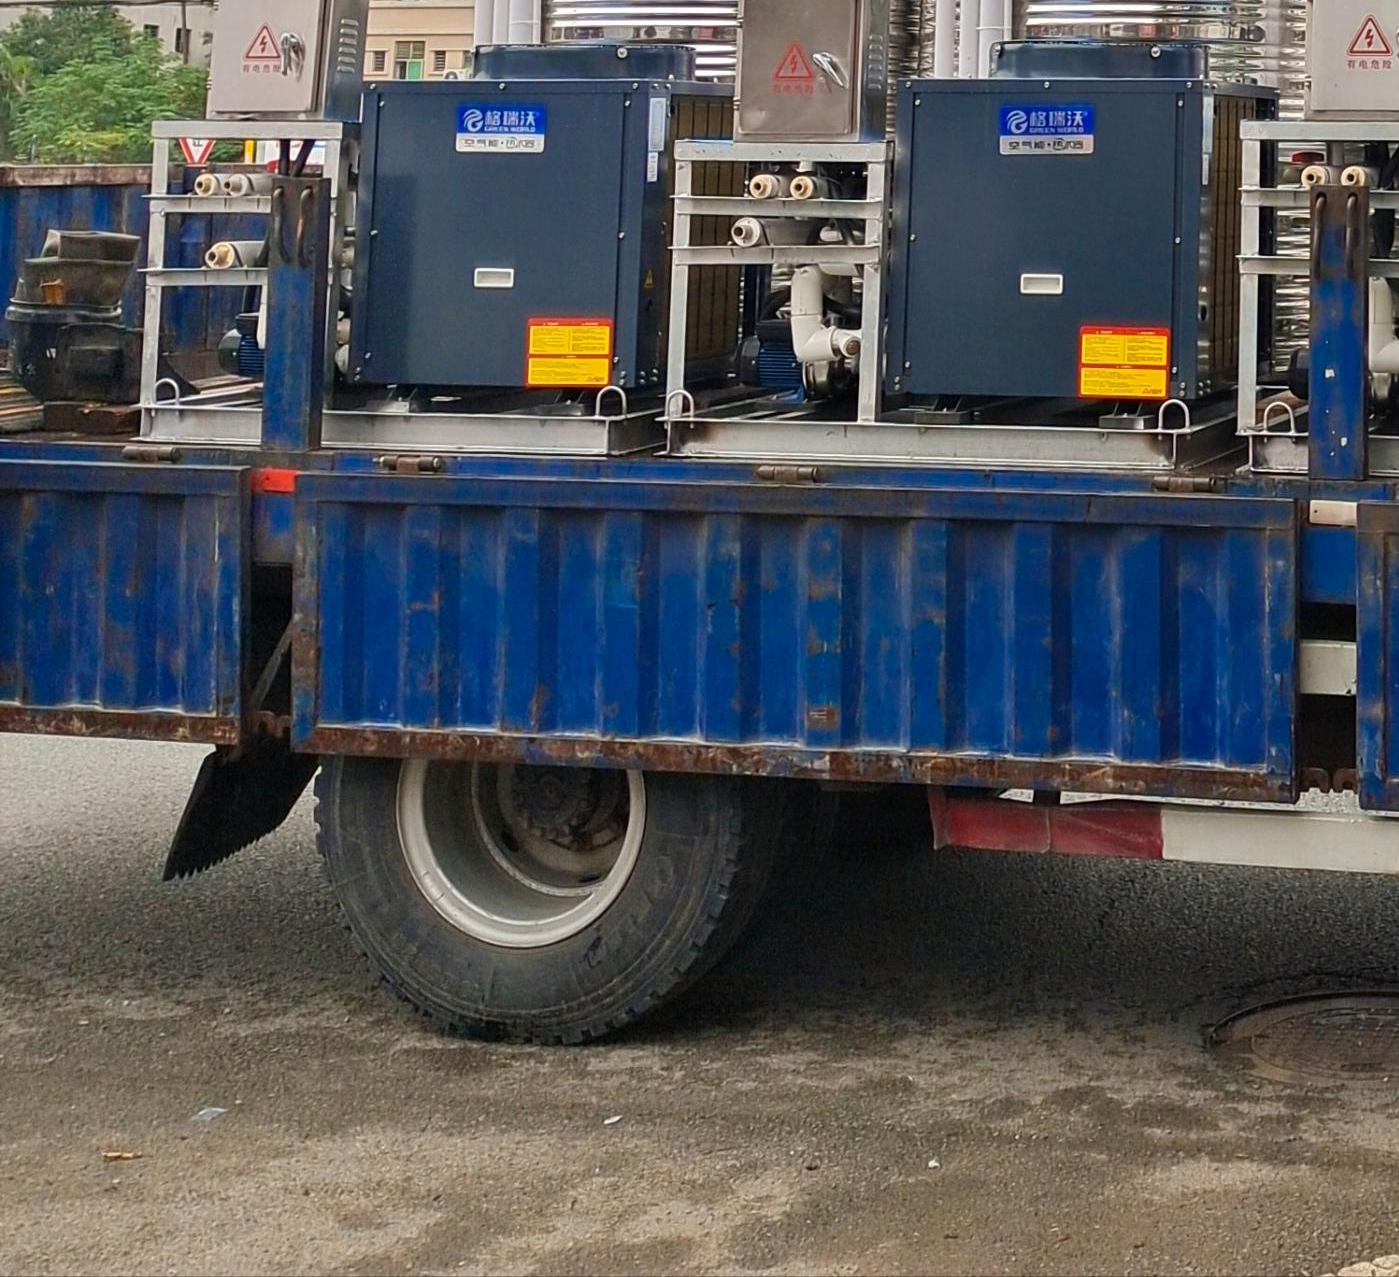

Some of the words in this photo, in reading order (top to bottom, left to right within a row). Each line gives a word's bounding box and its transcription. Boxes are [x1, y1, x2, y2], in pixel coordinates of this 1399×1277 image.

[1346, 59, 1392, 70] 有电危险
[1029, 110, 1085, 127] 格瑞沃
